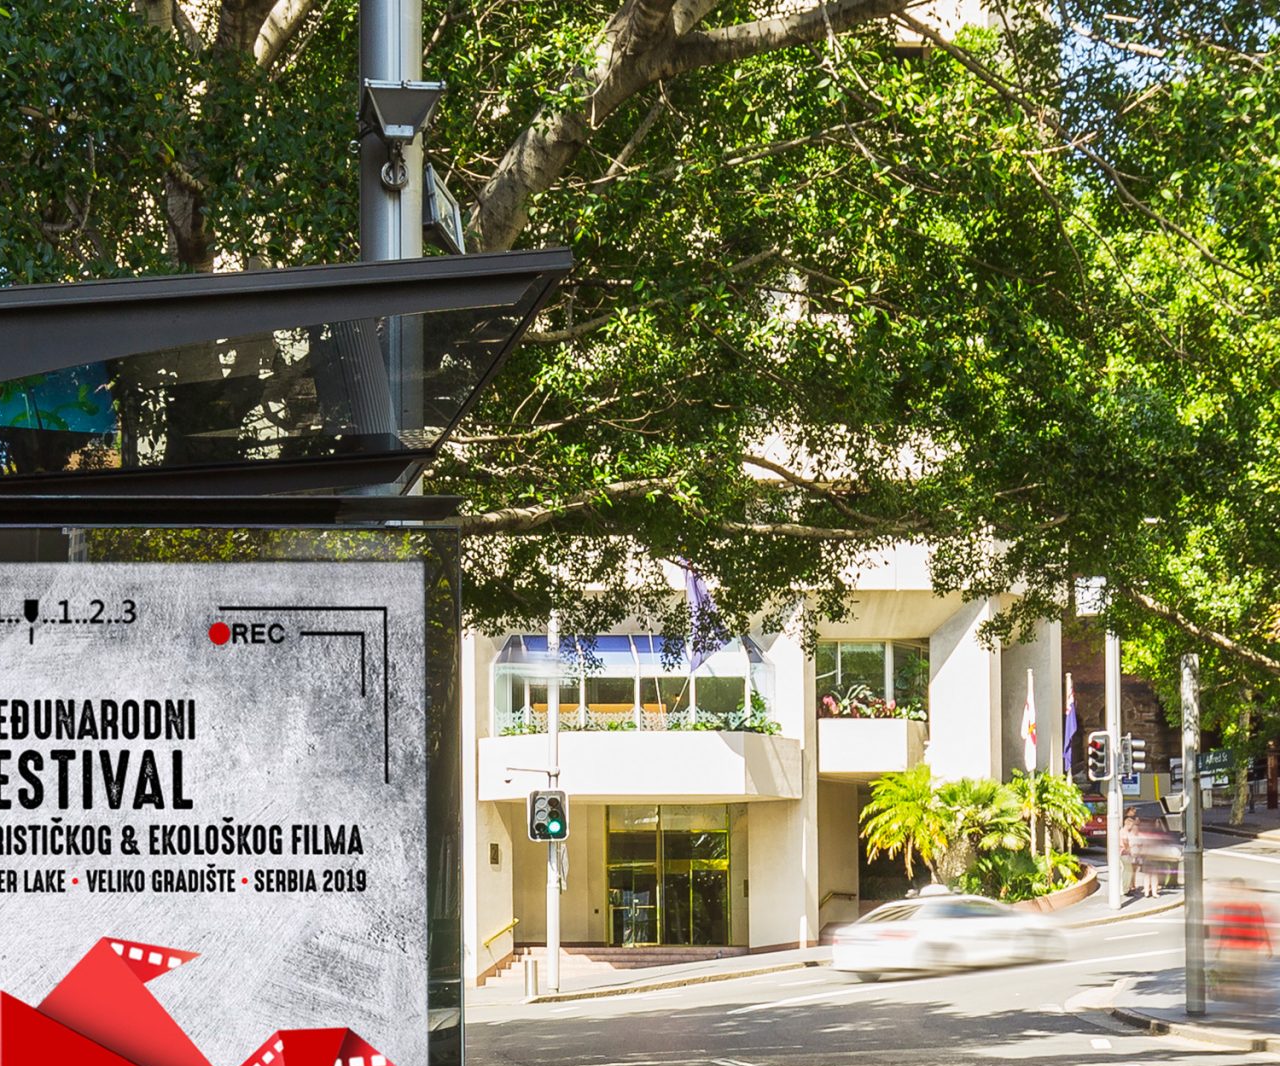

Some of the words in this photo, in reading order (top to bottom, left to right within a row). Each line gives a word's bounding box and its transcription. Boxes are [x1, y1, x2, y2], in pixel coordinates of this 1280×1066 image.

[231, 622, 286, 645] REC
[120, 824, 141, 856] &
[149, 816, 283, 856] EKOLOŠKOG
[291, 824, 364, 855] FILMA
[23, 869, 66, 893] LAKE
[86, 869, 145, 893] VELIKO
[151, 863, 236, 893] GRADIŠTE
[254, 869, 317, 893] SERBIA
[322, 868, 367, 893] 2019
